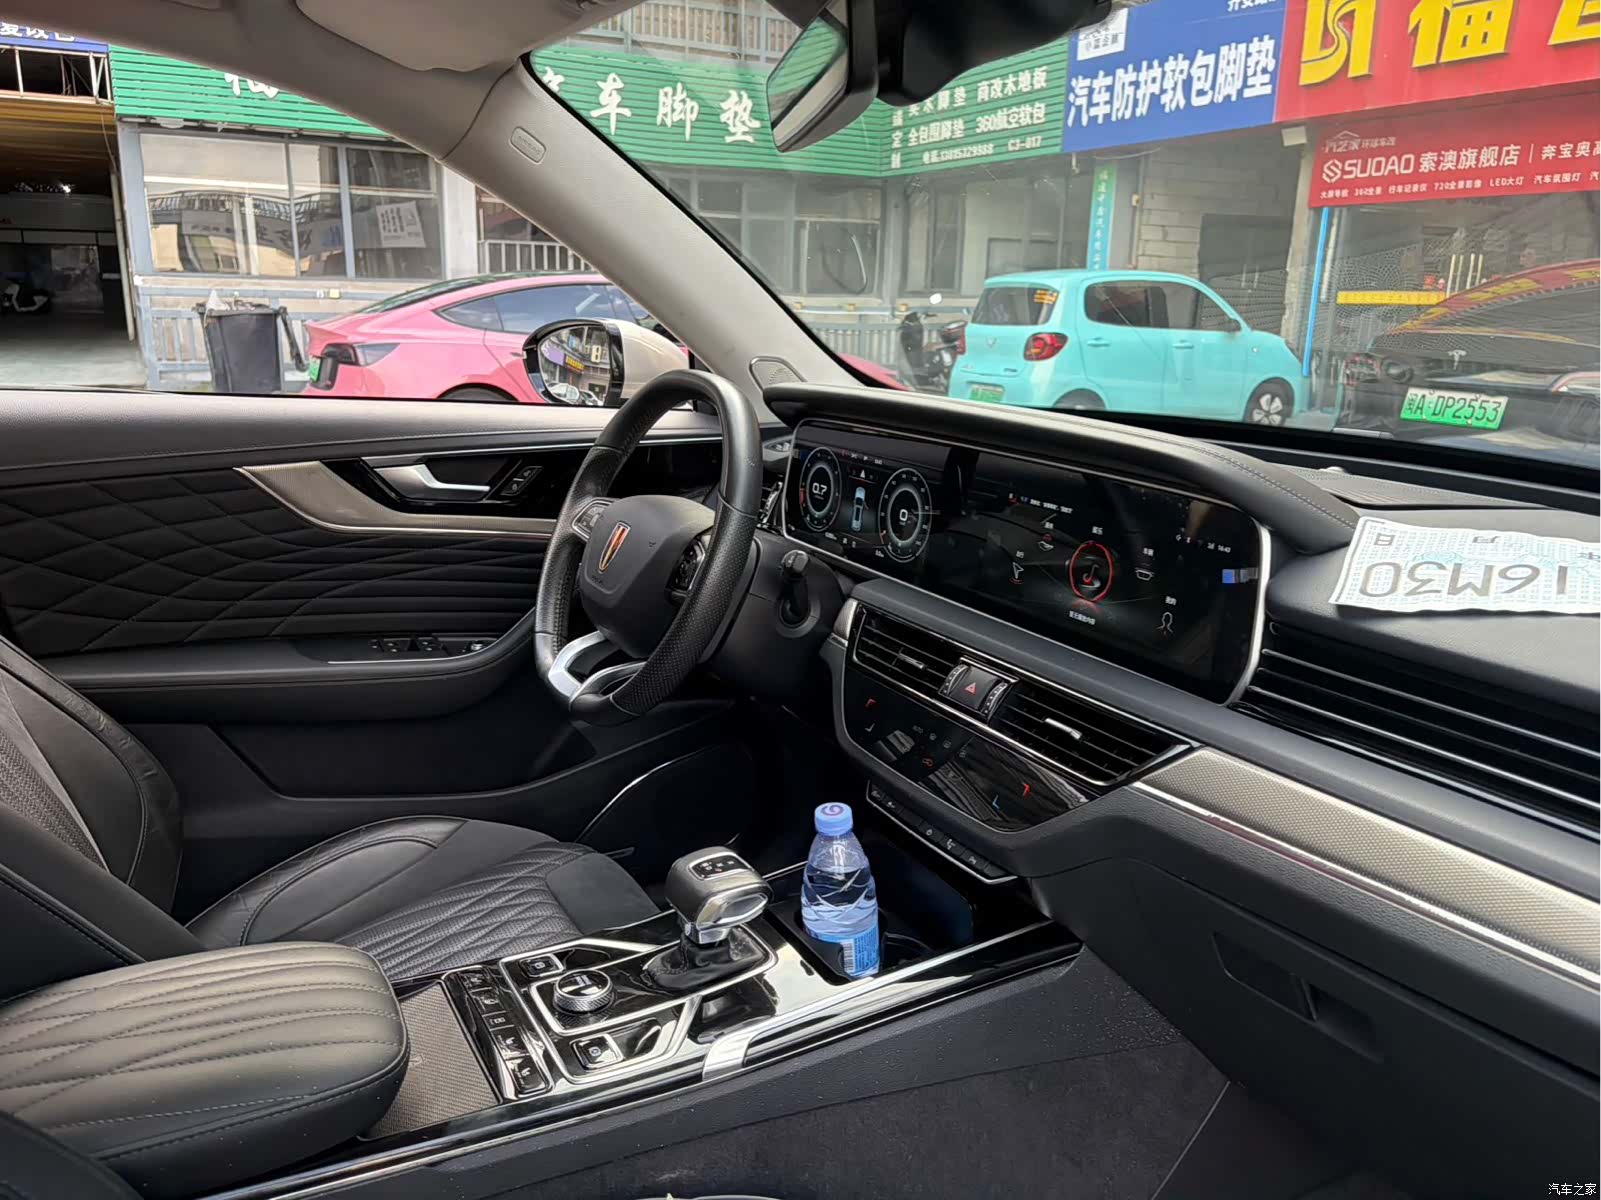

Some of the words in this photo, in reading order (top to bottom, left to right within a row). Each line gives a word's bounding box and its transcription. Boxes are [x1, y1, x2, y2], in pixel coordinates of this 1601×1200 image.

[1067, 35, 1276, 128] 汽车防护软包脚垫
[908, 118, 965, 147] 全包围脚垫
[976, 102, 1045, 134] 360航空软包
[1419, 144, 1521, 173] 索澳旗舰店
[812, 482, 828, 496] 0.7
